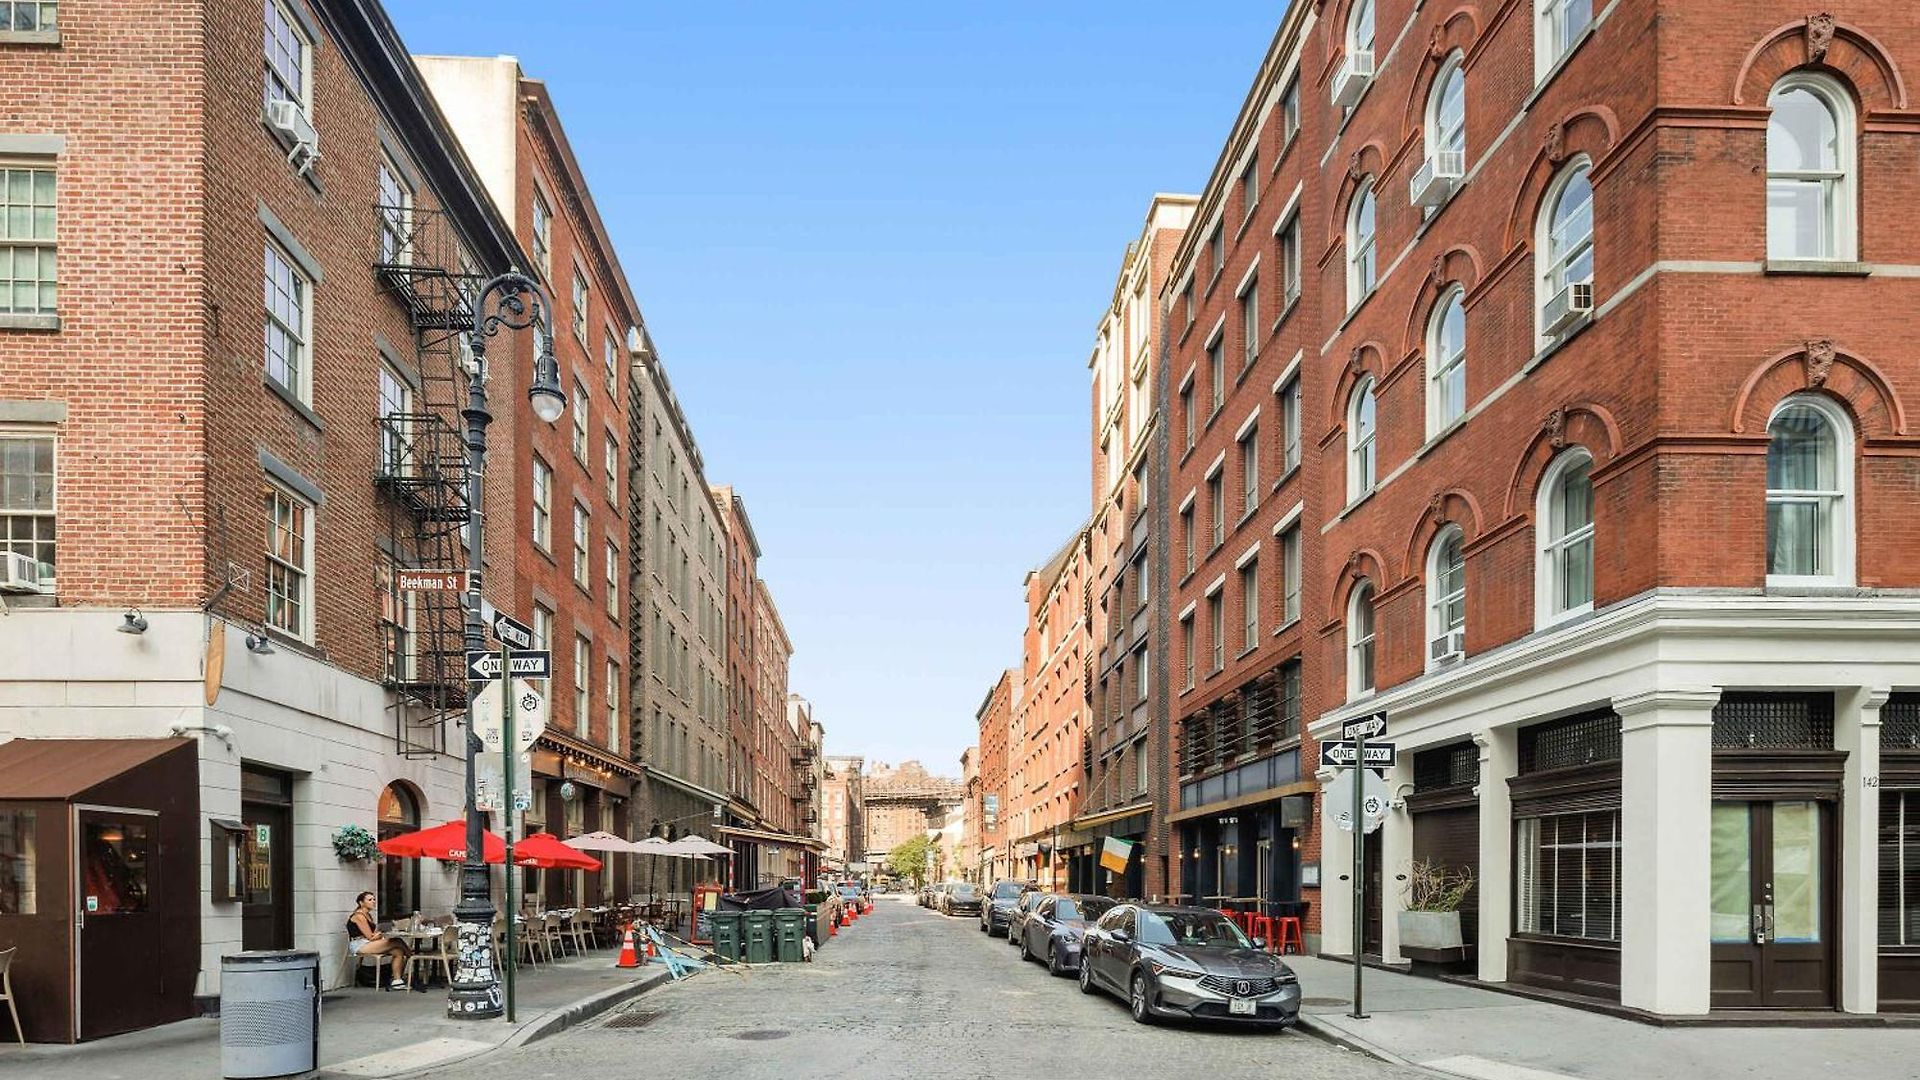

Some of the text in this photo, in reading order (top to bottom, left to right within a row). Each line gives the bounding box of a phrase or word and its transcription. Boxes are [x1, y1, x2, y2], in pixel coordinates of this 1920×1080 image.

[400, 575, 458, 590] Beekman St
[512, 660, 539, 671] WAY
[1347, 720, 1380, 736] ONE WAY
[1333, 749, 1386, 759] ONE WAY
[1863, 776, 1879, 788] 142
